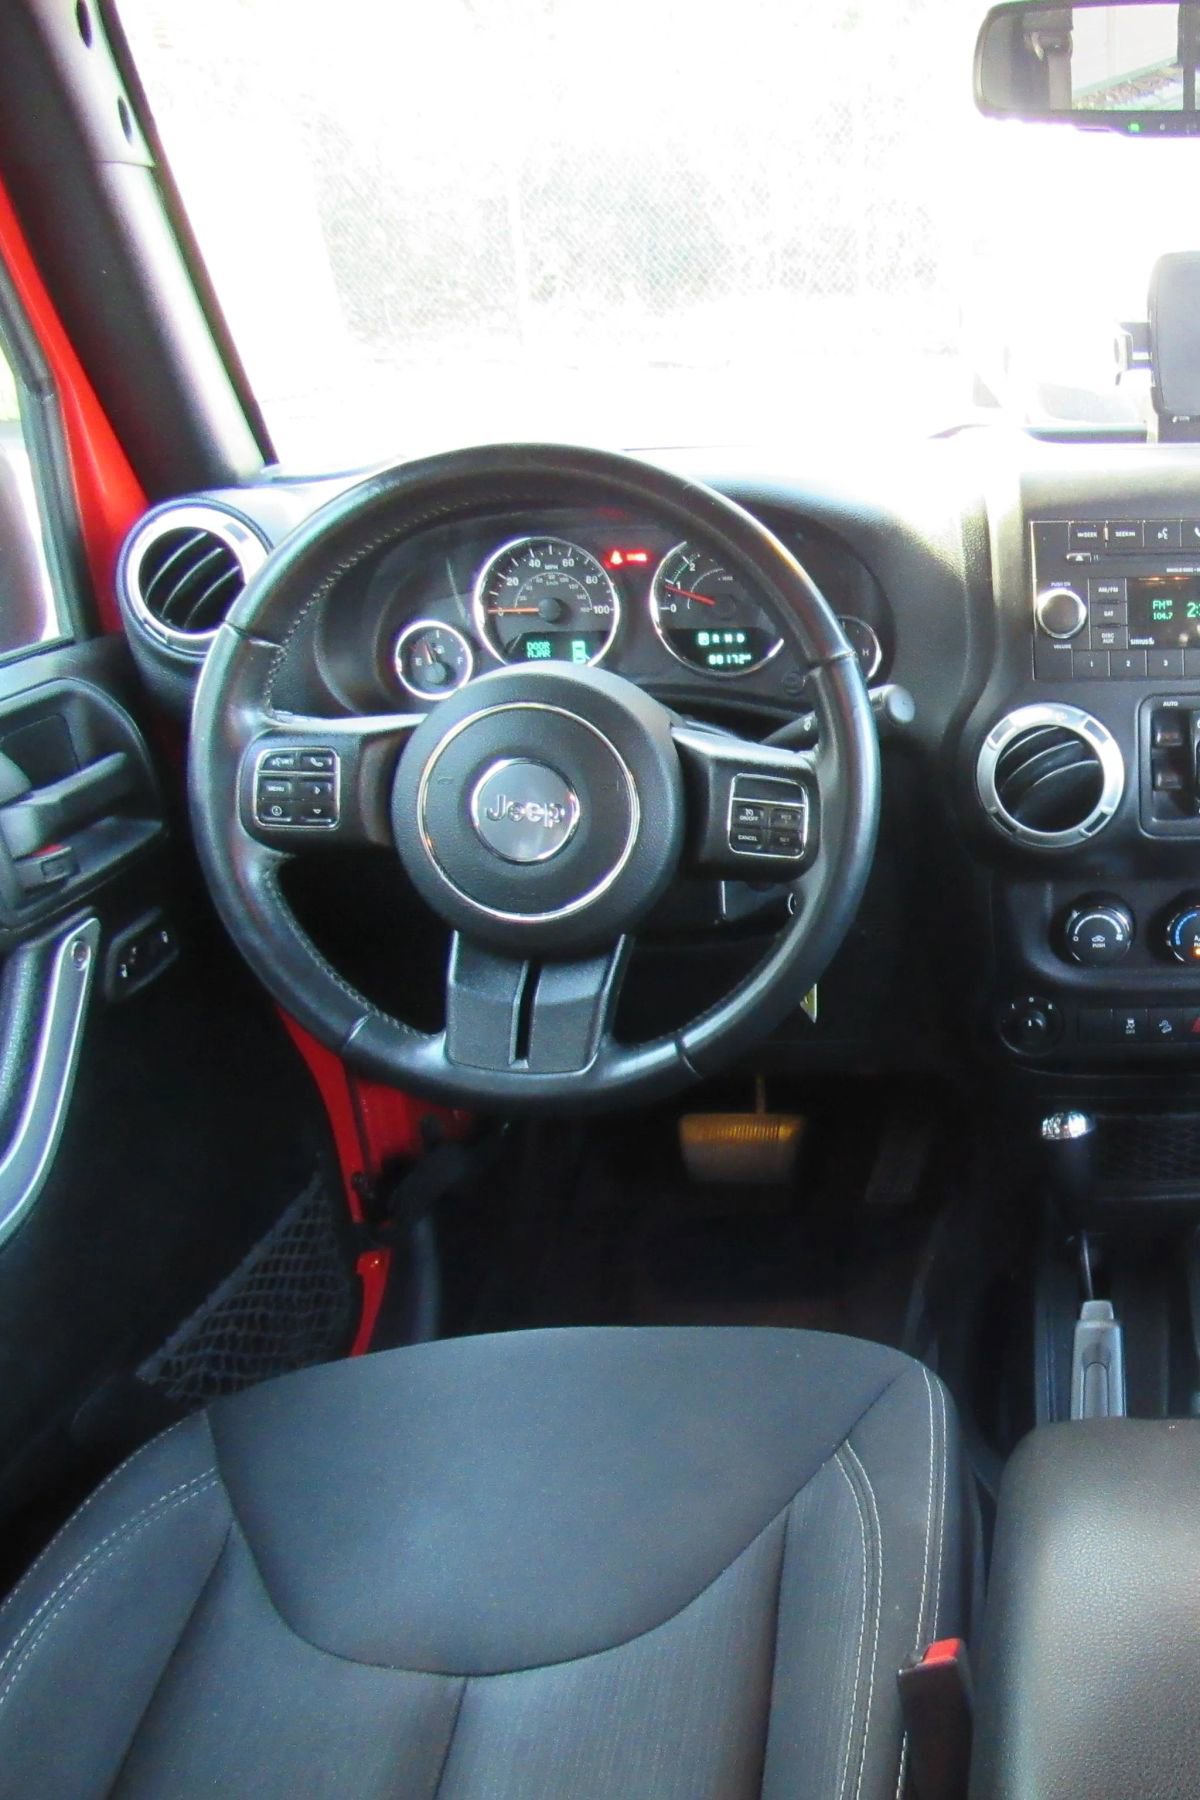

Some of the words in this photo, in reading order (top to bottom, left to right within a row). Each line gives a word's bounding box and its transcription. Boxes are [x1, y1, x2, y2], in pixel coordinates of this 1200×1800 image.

[528, 559, 540, 568] 40
[562, 558, 574, 567] 60
[690, 564, 696, 572] 2
[506, 577, 519, 586] 20
[586, 576, 598, 584] 80
[593, 606, 610, 614] 100
[670, 604, 676, 612] 0
[458, 656, 464, 665] F
[484, 794, 566, 828] Jeep
[738, 834, 758, 842] CANCEL
